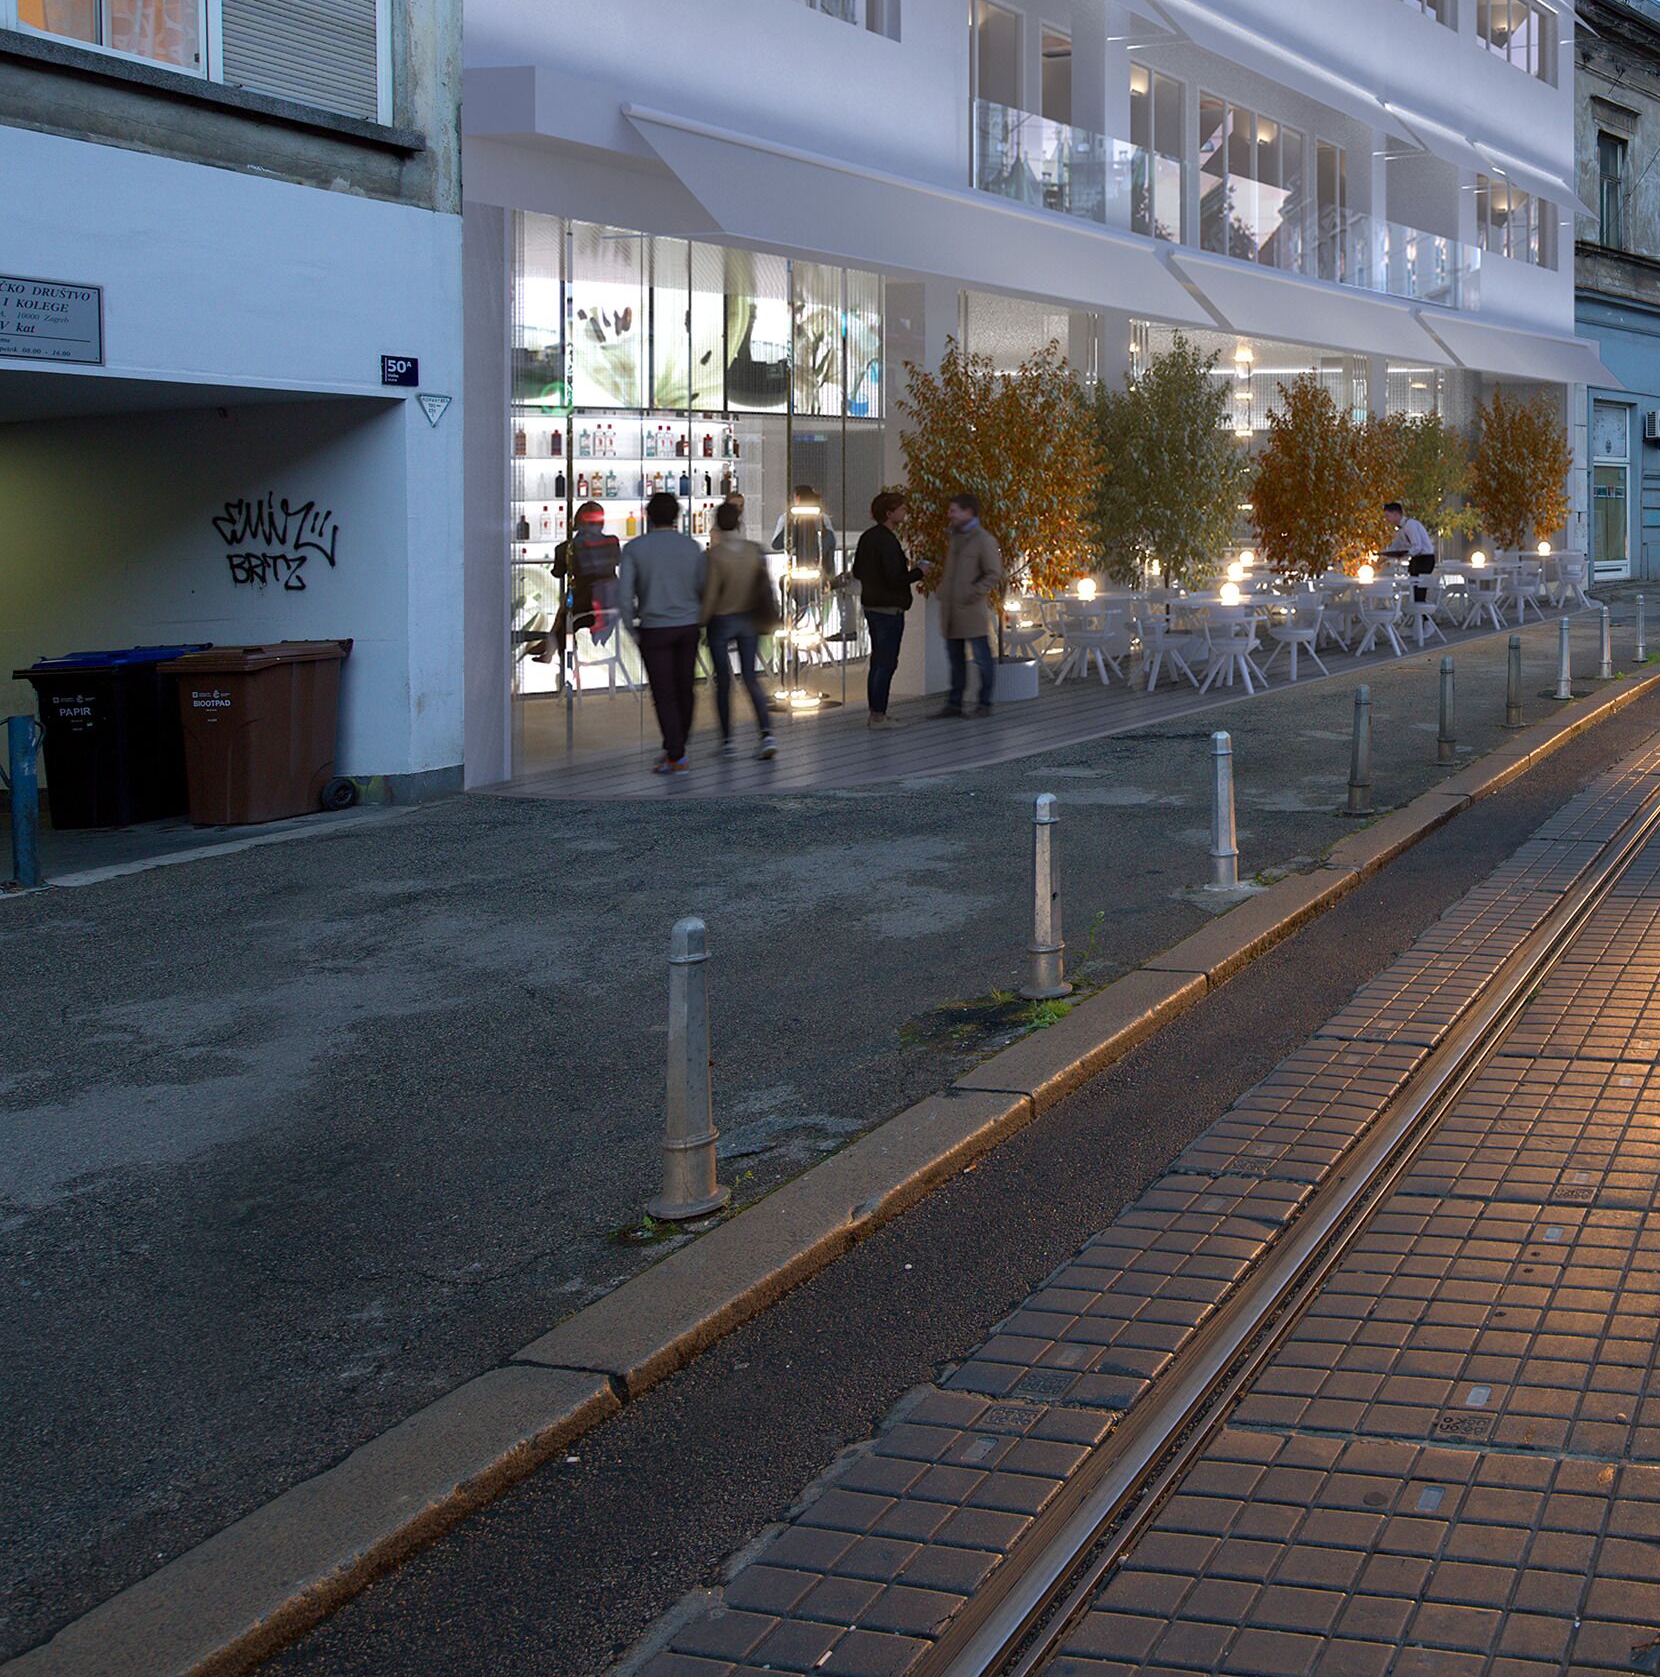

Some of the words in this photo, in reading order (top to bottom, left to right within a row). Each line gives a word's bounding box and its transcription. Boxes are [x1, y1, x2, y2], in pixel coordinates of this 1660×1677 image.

[32, 286, 91, 301] DRUŠTVO
[16, 298, 70, 313] KOLEGE
[44, 315, 70, 324] Zagreb
[16, 322, 36, 333] kat
[193, 699, 231, 707] BIOOTPAD
[59, 707, 92, 717] PAPIR
